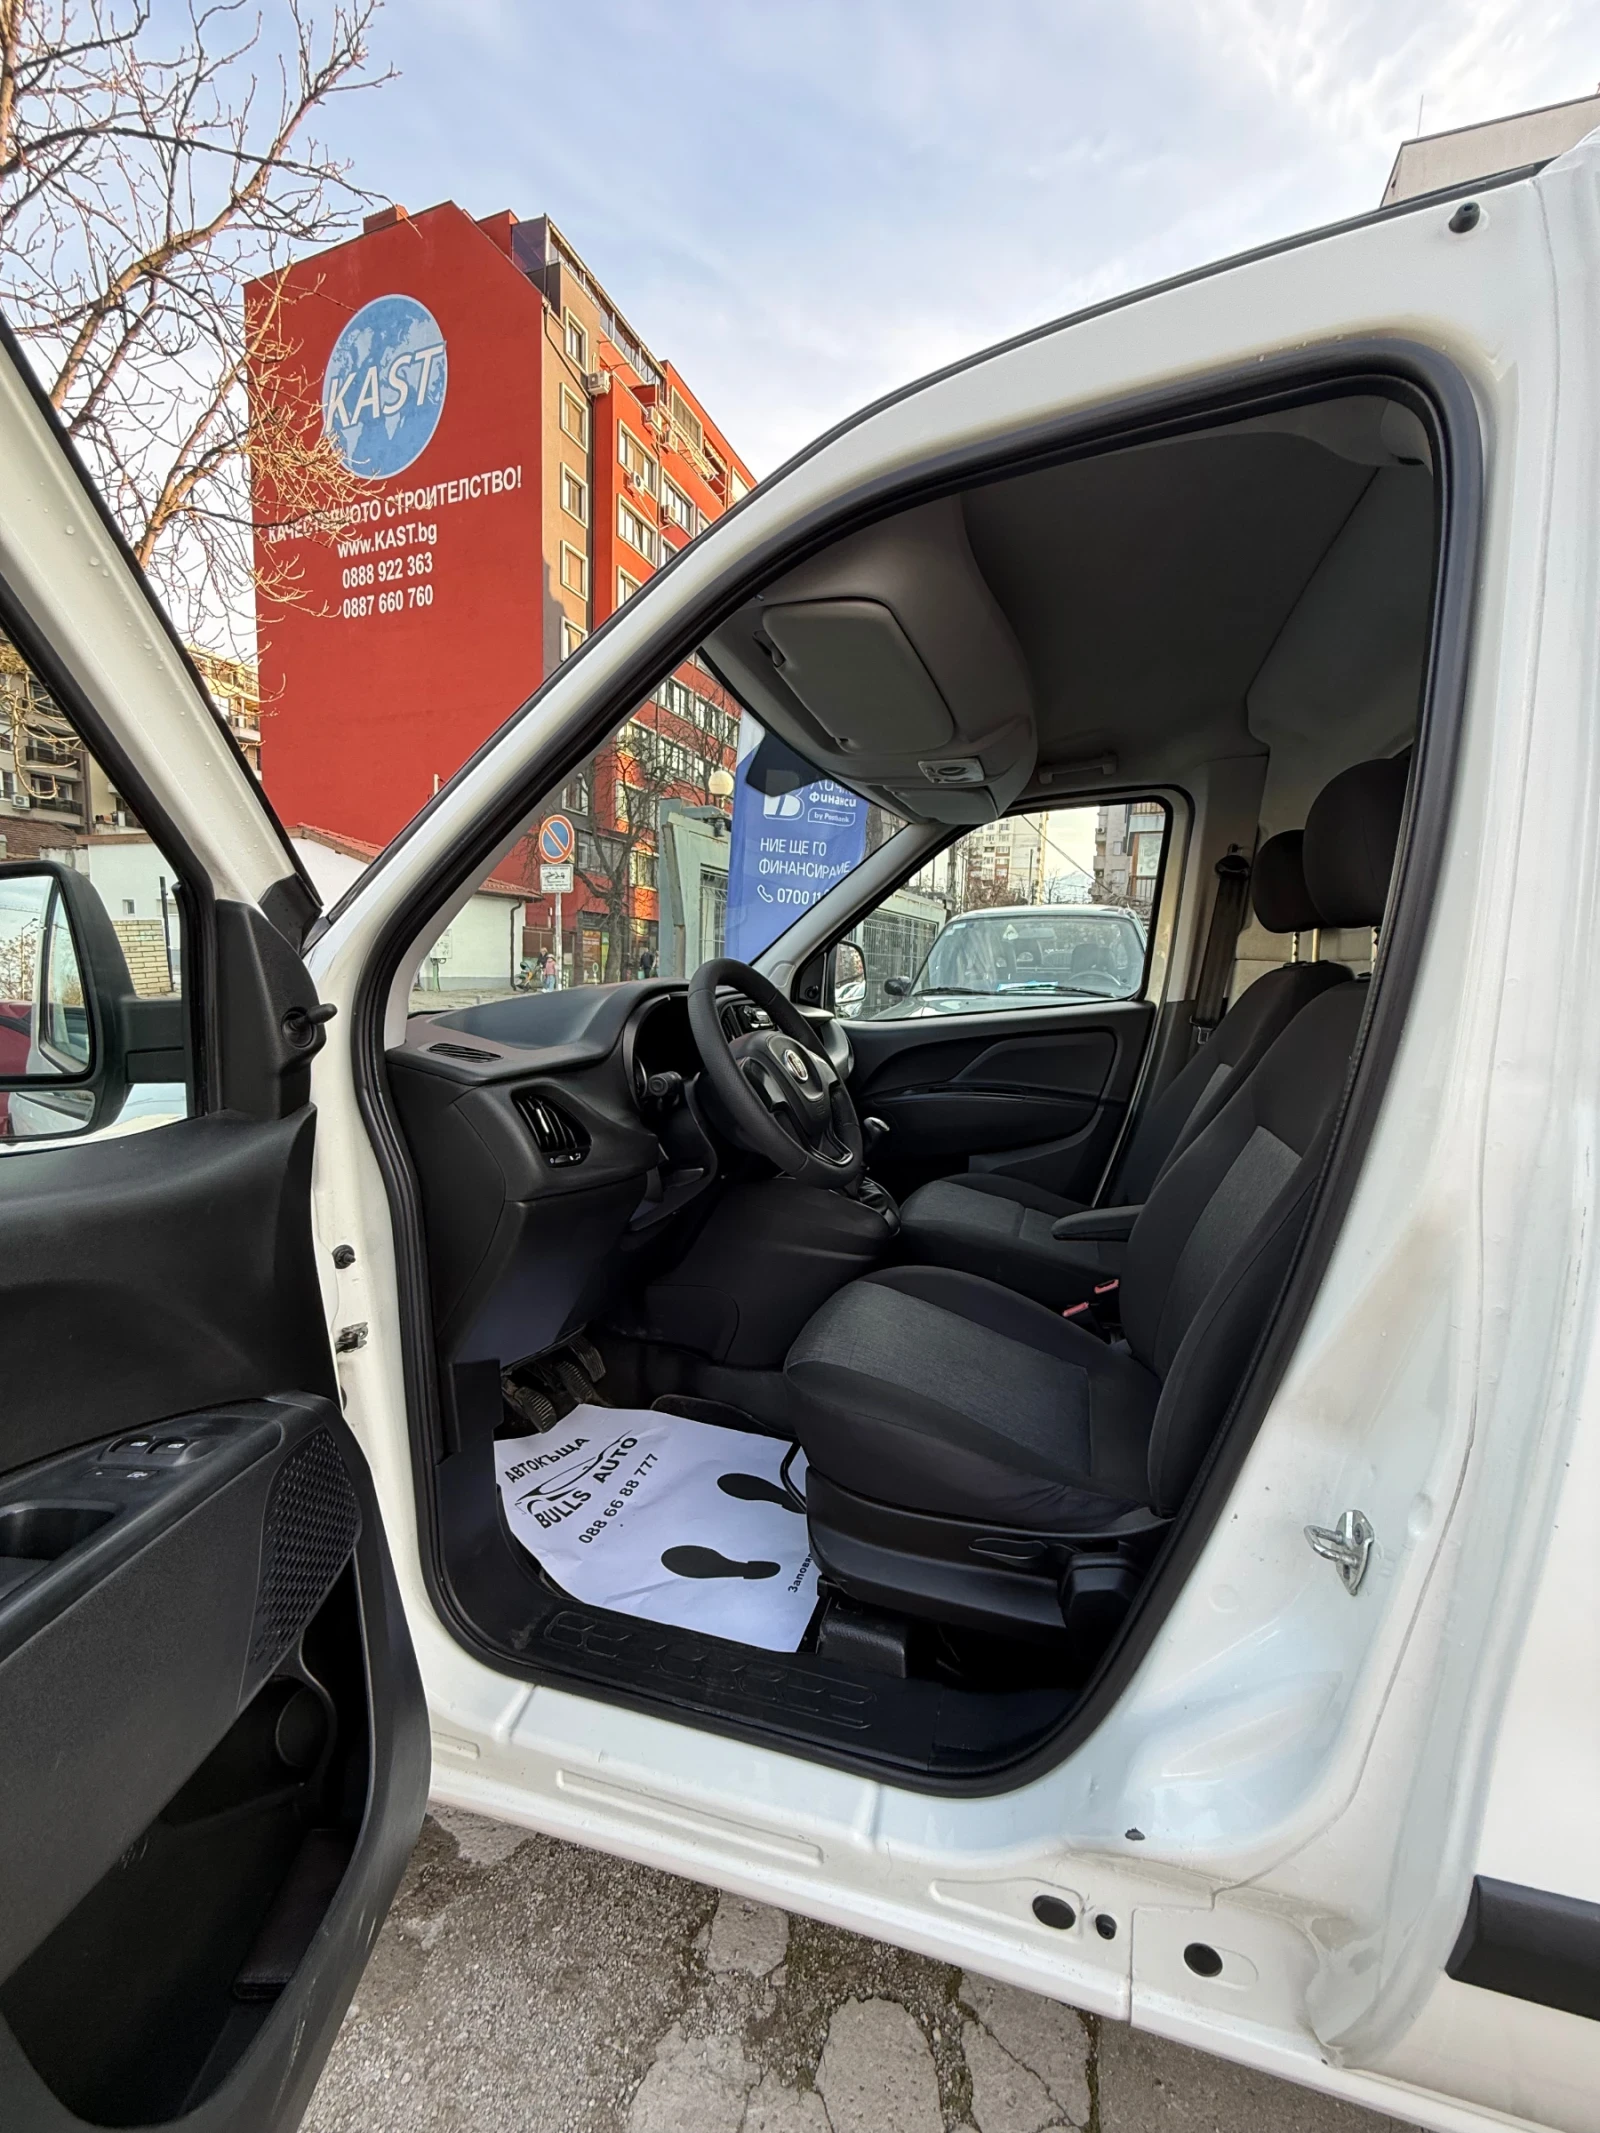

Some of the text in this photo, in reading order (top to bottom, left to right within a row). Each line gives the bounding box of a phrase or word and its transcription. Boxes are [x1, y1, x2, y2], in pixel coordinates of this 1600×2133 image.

[324, 343, 445, 433] KAST
[384, 465, 522, 518] СТРОИТЕЛСТВО!
[337, 522, 438, 559] www.KAST.bg
[342, 552, 433, 589] 0888 922 363
[343, 584, 434, 619] 0887 660 760
[814, 811, 823, 821] by
[760, 837, 827, 857] НИЕ ЩЕ ГО
[777, 887, 810, 905] 0700
[504, 1438, 591, 1484] АВТОКЪЩА
[533, 1437, 638, 1529] BULLS AUTO
[578, 1453, 659, 1544] 088 66 88 777
